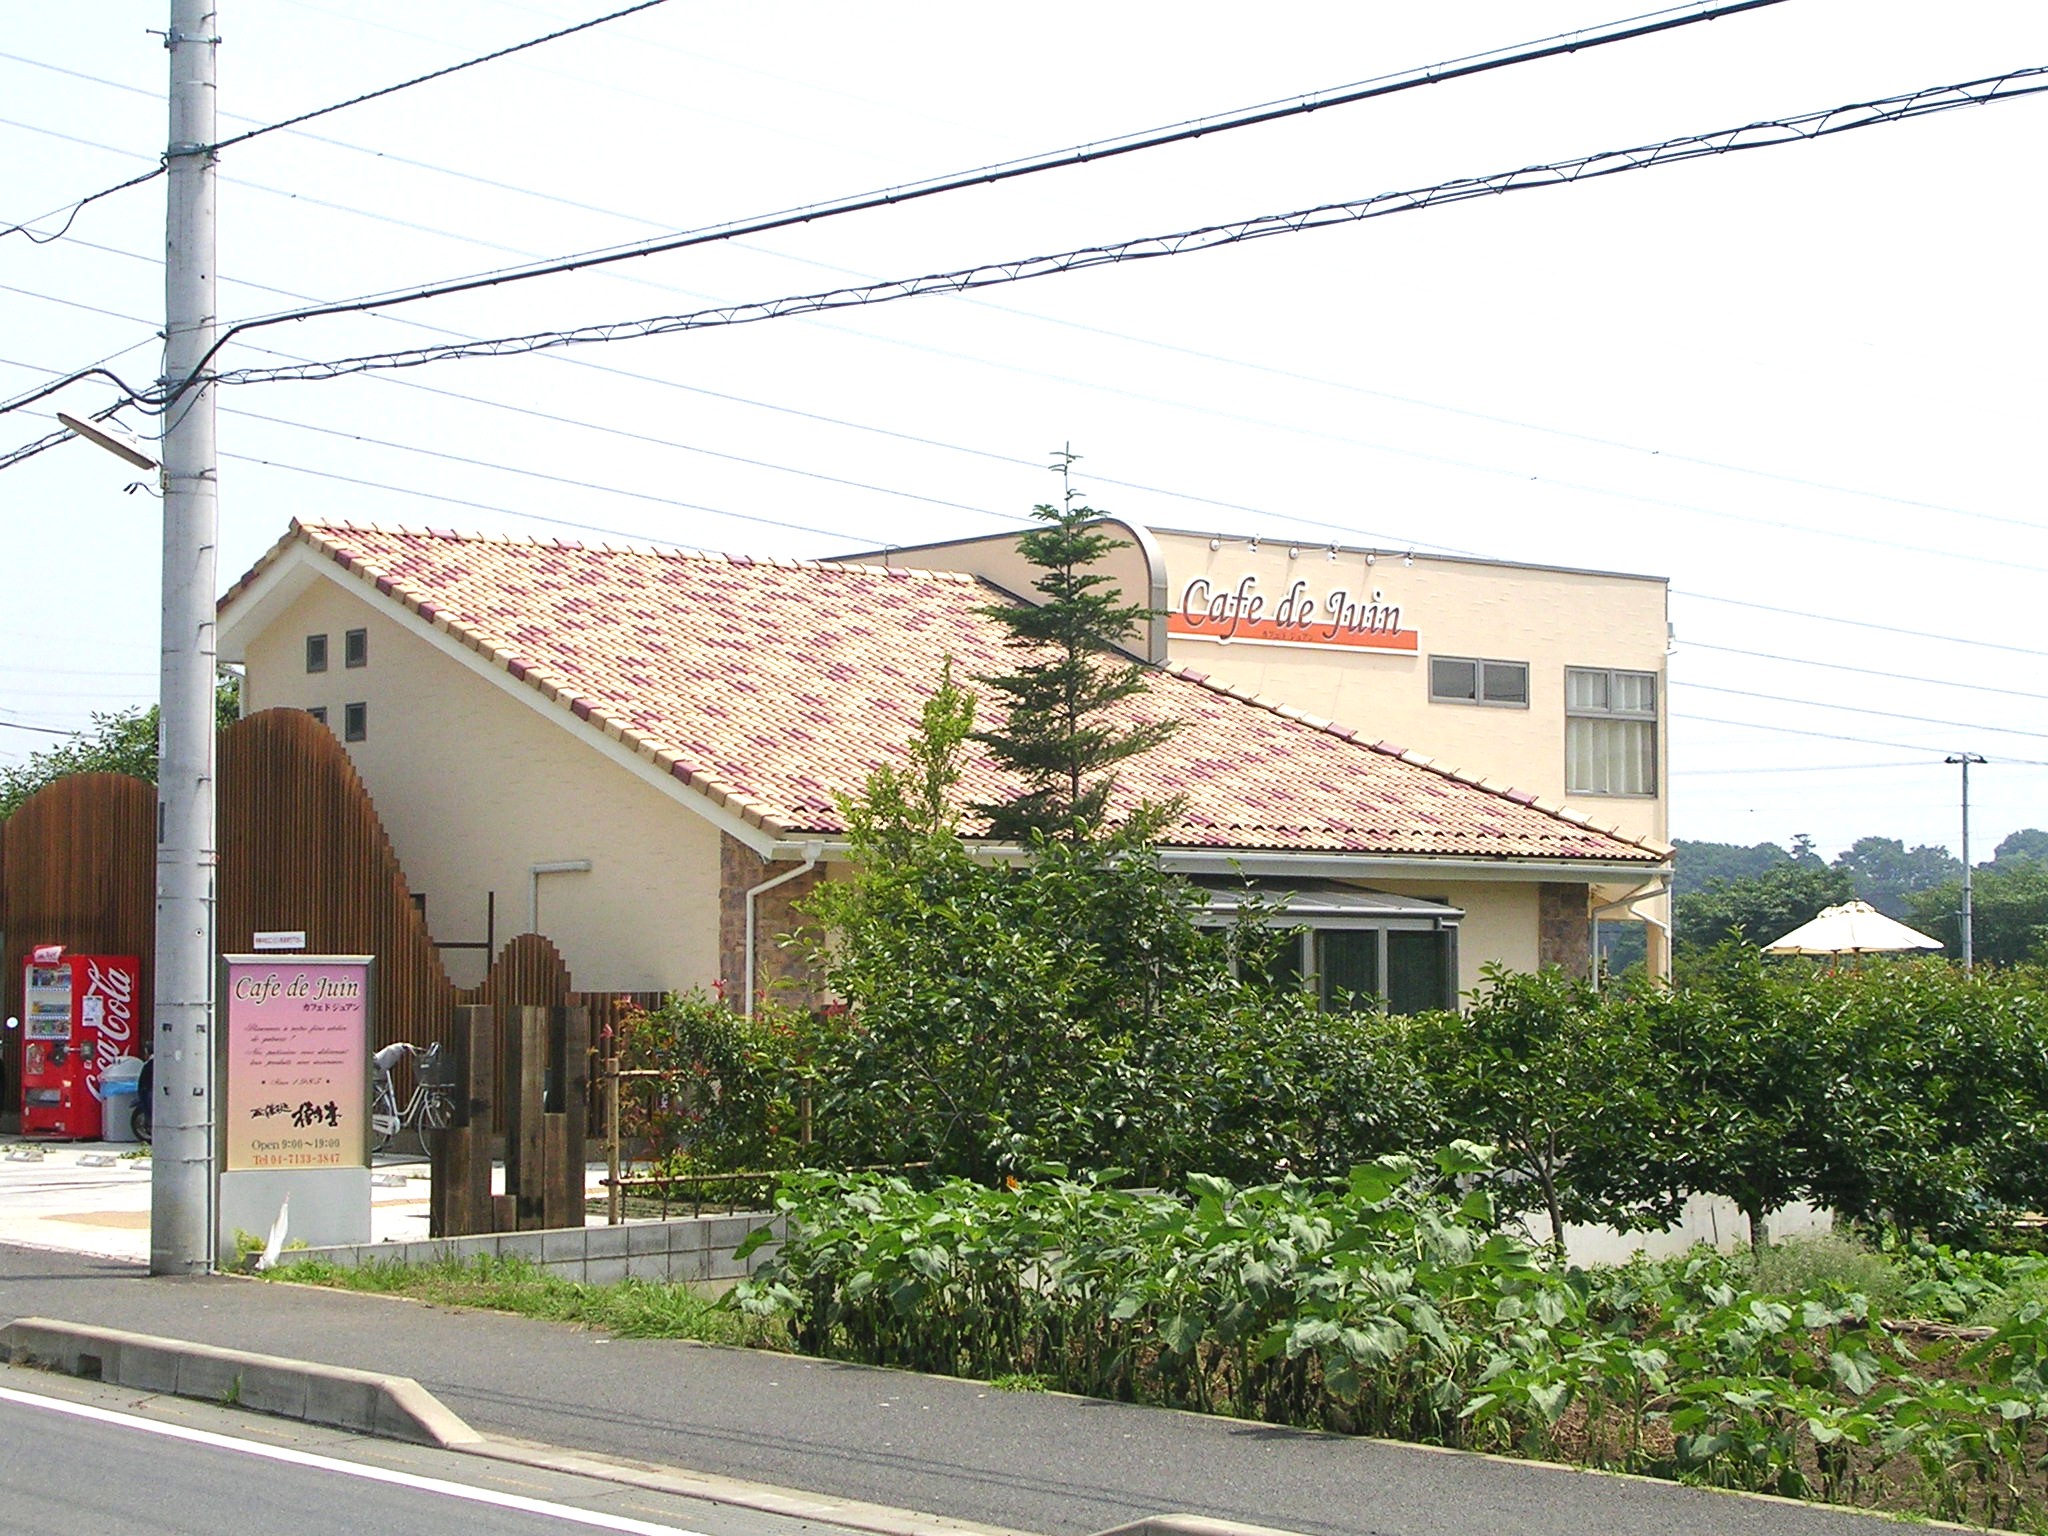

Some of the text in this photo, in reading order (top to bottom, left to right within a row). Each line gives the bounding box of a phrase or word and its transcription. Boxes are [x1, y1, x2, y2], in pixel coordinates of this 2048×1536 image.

[1183, 576, 1402, 640] Cafe de Juin
[235, 973, 359, 1004] Cafe de Juin
[251, 1139, 280, 1151] Open
[253, 1154, 268, 1165] Tel
